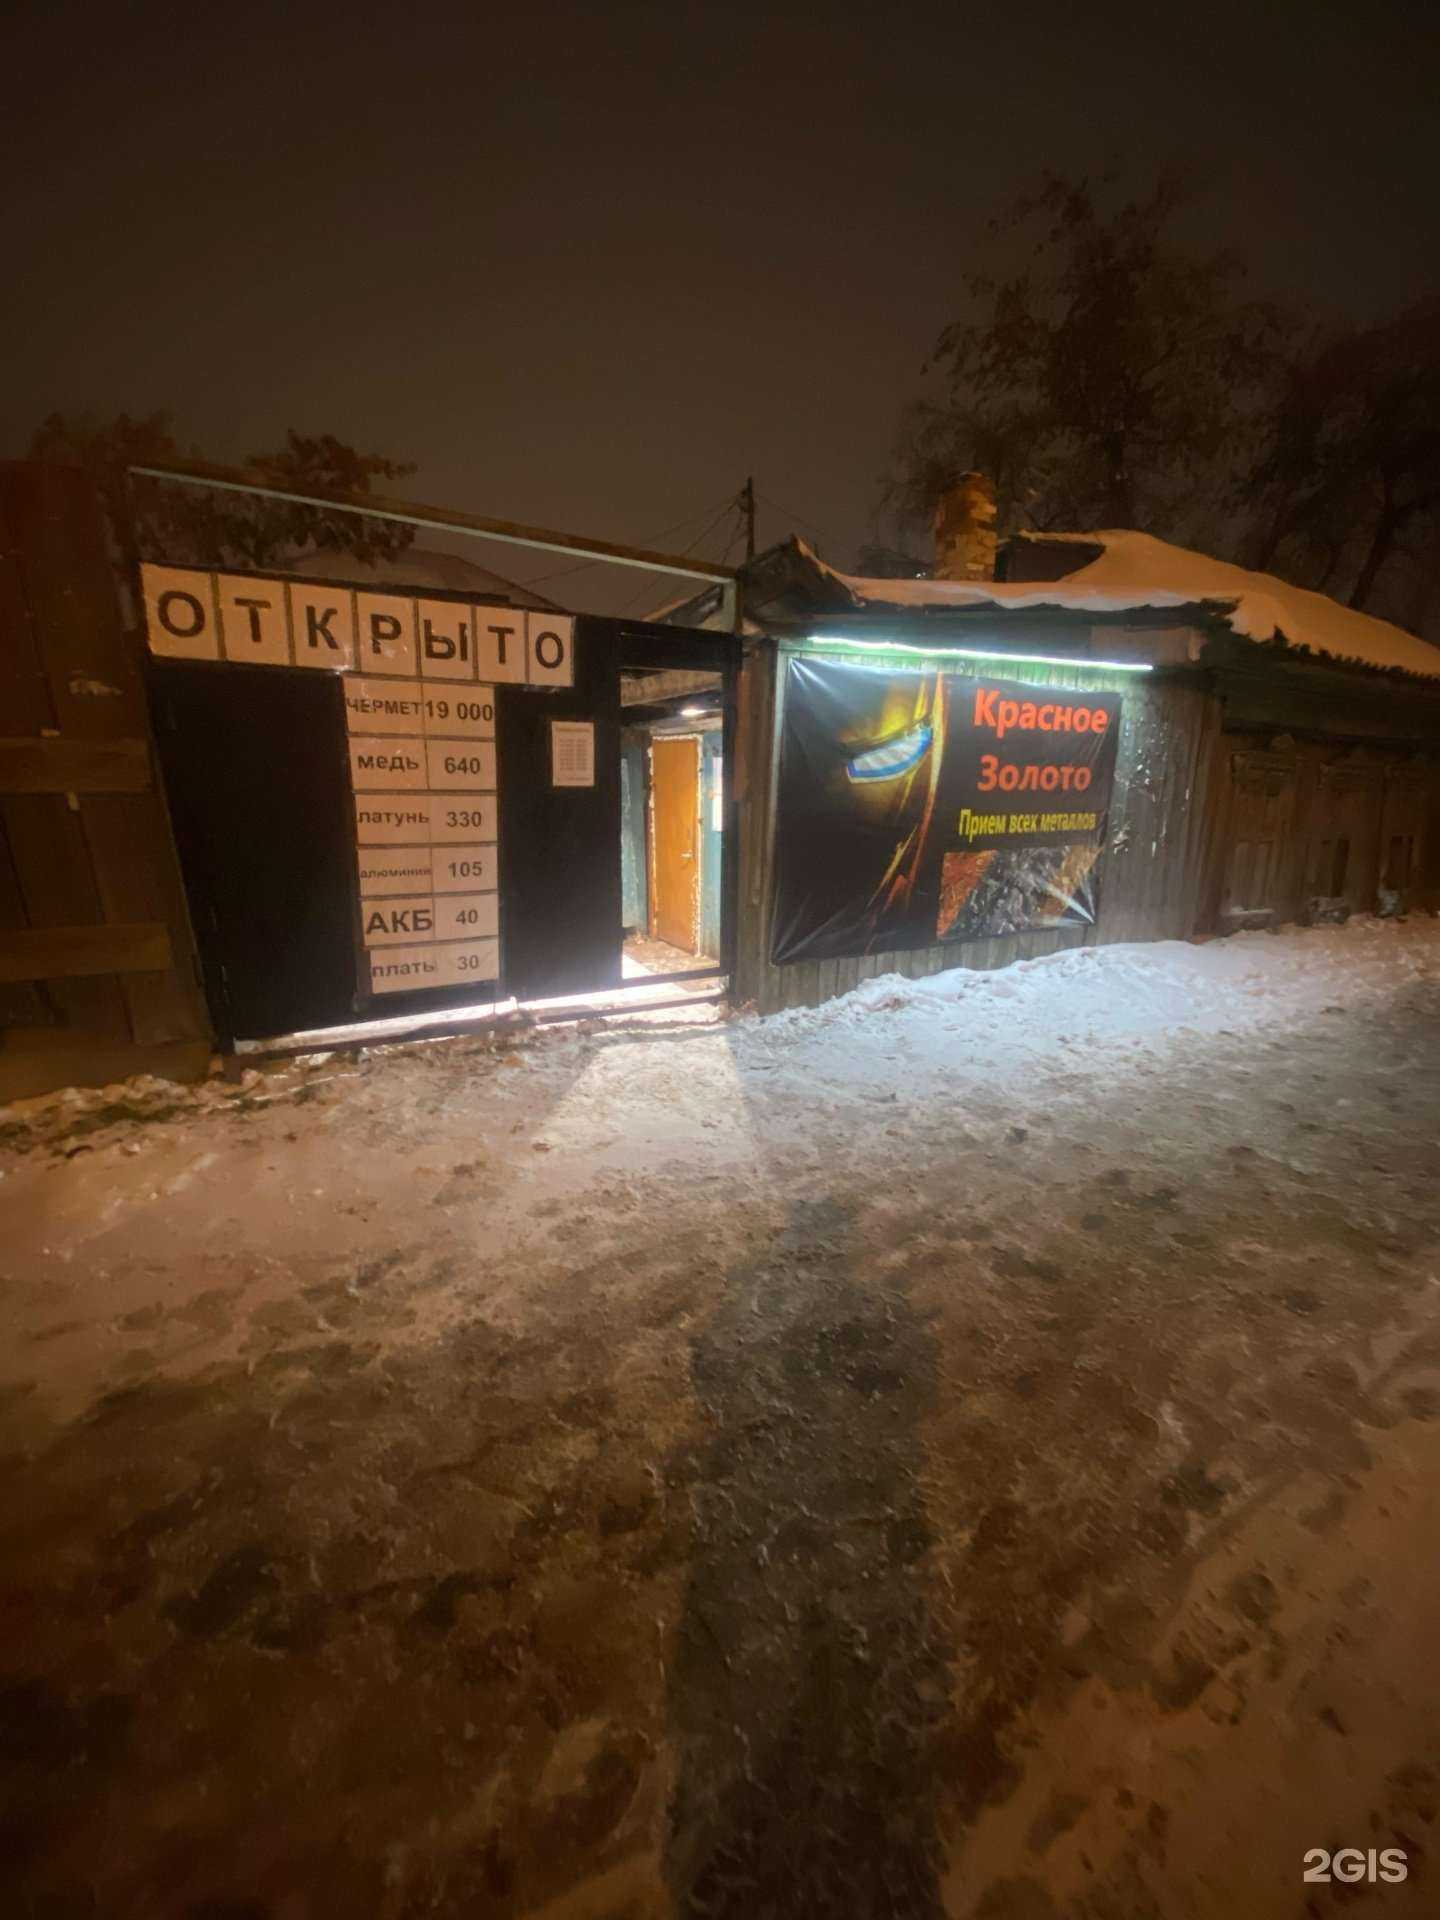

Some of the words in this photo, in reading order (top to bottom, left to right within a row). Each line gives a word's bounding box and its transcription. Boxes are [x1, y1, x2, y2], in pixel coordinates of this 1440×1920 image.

[158, 590, 565, 669] ОТКРЫТО
[346, 698, 423, 715] ЧЕРМЕТ
[425, 700, 449, 719] 19
[456, 702, 494, 721] 000
[973, 687, 1109, 739] Красное
[357, 755, 420, 772] медь
[444, 757, 481, 775] 640
[976, 753, 1093, 792] Золото
[357, 811, 430, 827] латунь
[446, 811, 483, 828] 330
[959, 808, 1006, 843] Прием
[1008, 813, 1037, 834] всех
[1039, 812, 1097, 832] металлов
[448, 861, 483, 878] 105
[366, 909, 433, 935] АКБ
[455, 909, 479, 925] 40
[457, 954, 480, 971] 30
